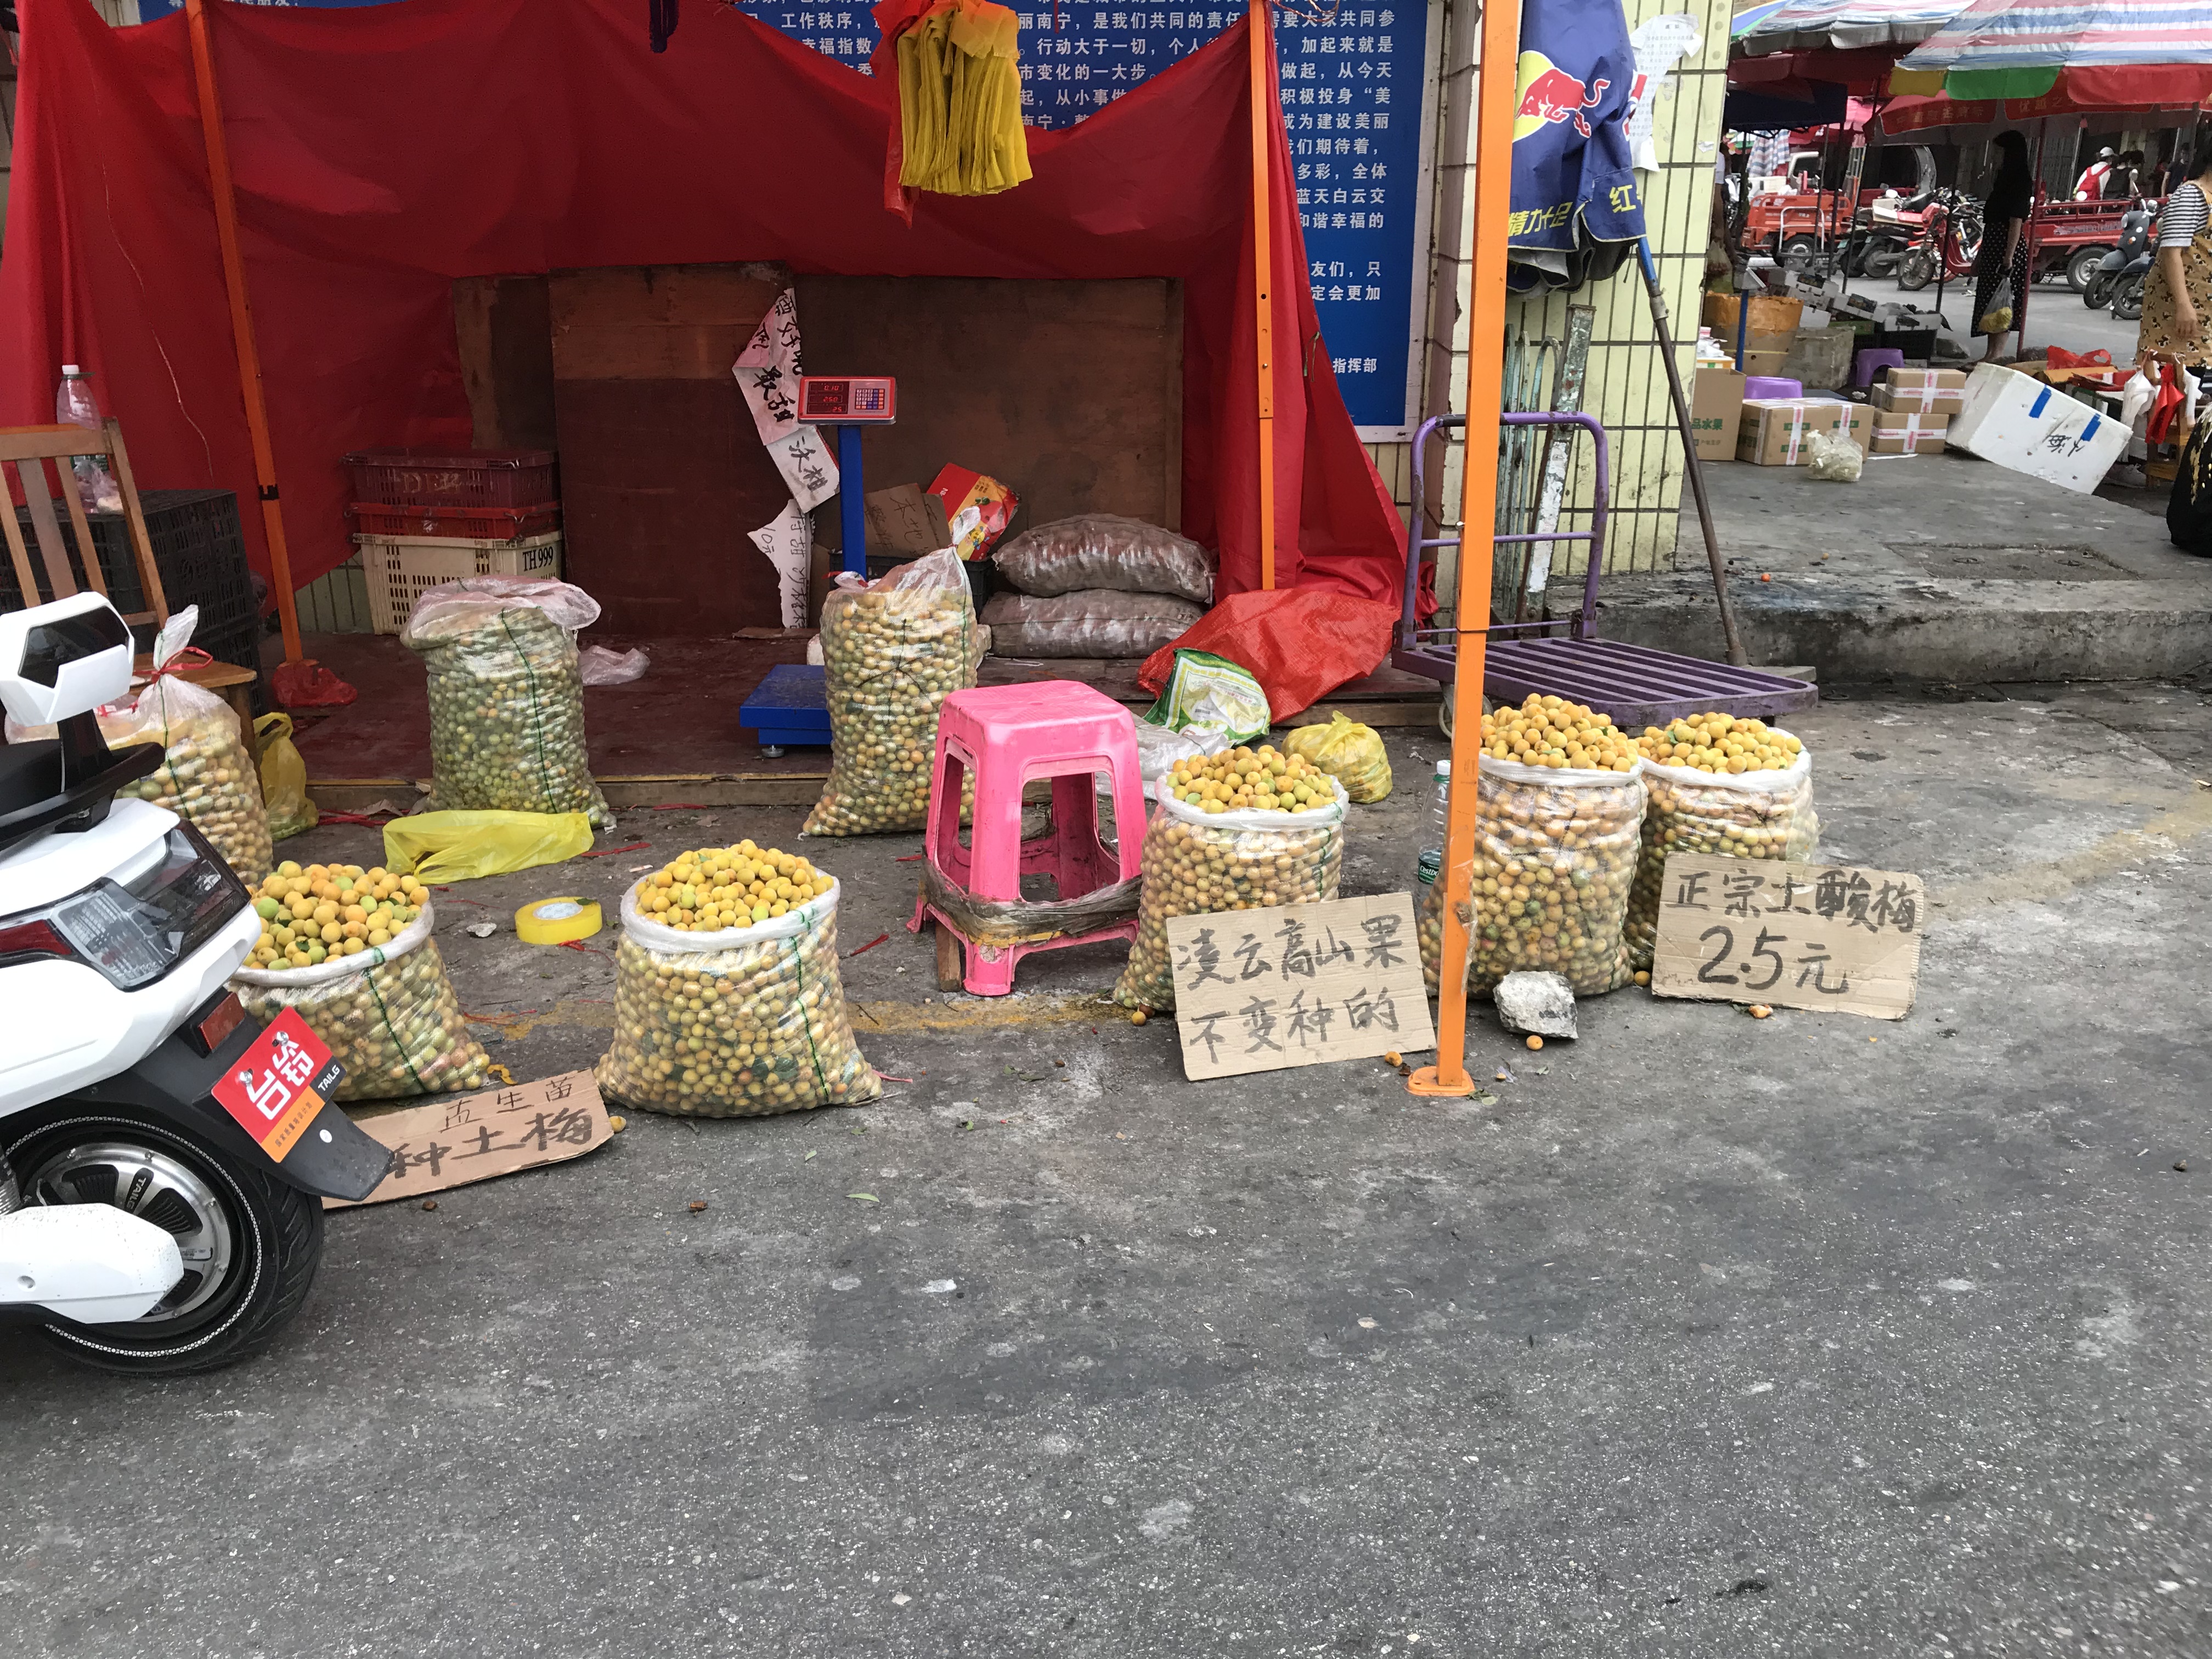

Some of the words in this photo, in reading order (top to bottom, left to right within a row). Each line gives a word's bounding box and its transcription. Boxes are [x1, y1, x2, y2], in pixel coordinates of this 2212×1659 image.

[781, 12, 881, 30] 工作秩序，
[1019, 36, 1219, 55] 。行动大于一切，个人
[1274, 35, 1394, 54] ，加起来就是
[1282, 61, 1392, 80] 做起，从今天
[1297, 162, 1387, 180] 多彩，全体
[1296, 187, 1386, 205] 蓝天白云交
[1609, 184, 1641, 213] 红
[1299, 211, 1384, 229] 和谐幸福的
[1508, 201, 1573, 238] 精力十足
[1311, 261, 1381, 278] 友们，只
[1311, 285, 1381, 301] 定会更加
[1333, 358, 1377, 374] 指挥部
[1664, 868, 1918, 933] 正宗土酸梅
[1697, 925, 1849, 995] 2.5元
[1189, 986, 1400, 1065] 不变种的
[318, 1064, 340, 1091] TAILG
[127, 1177, 146, 1210] TAILG
